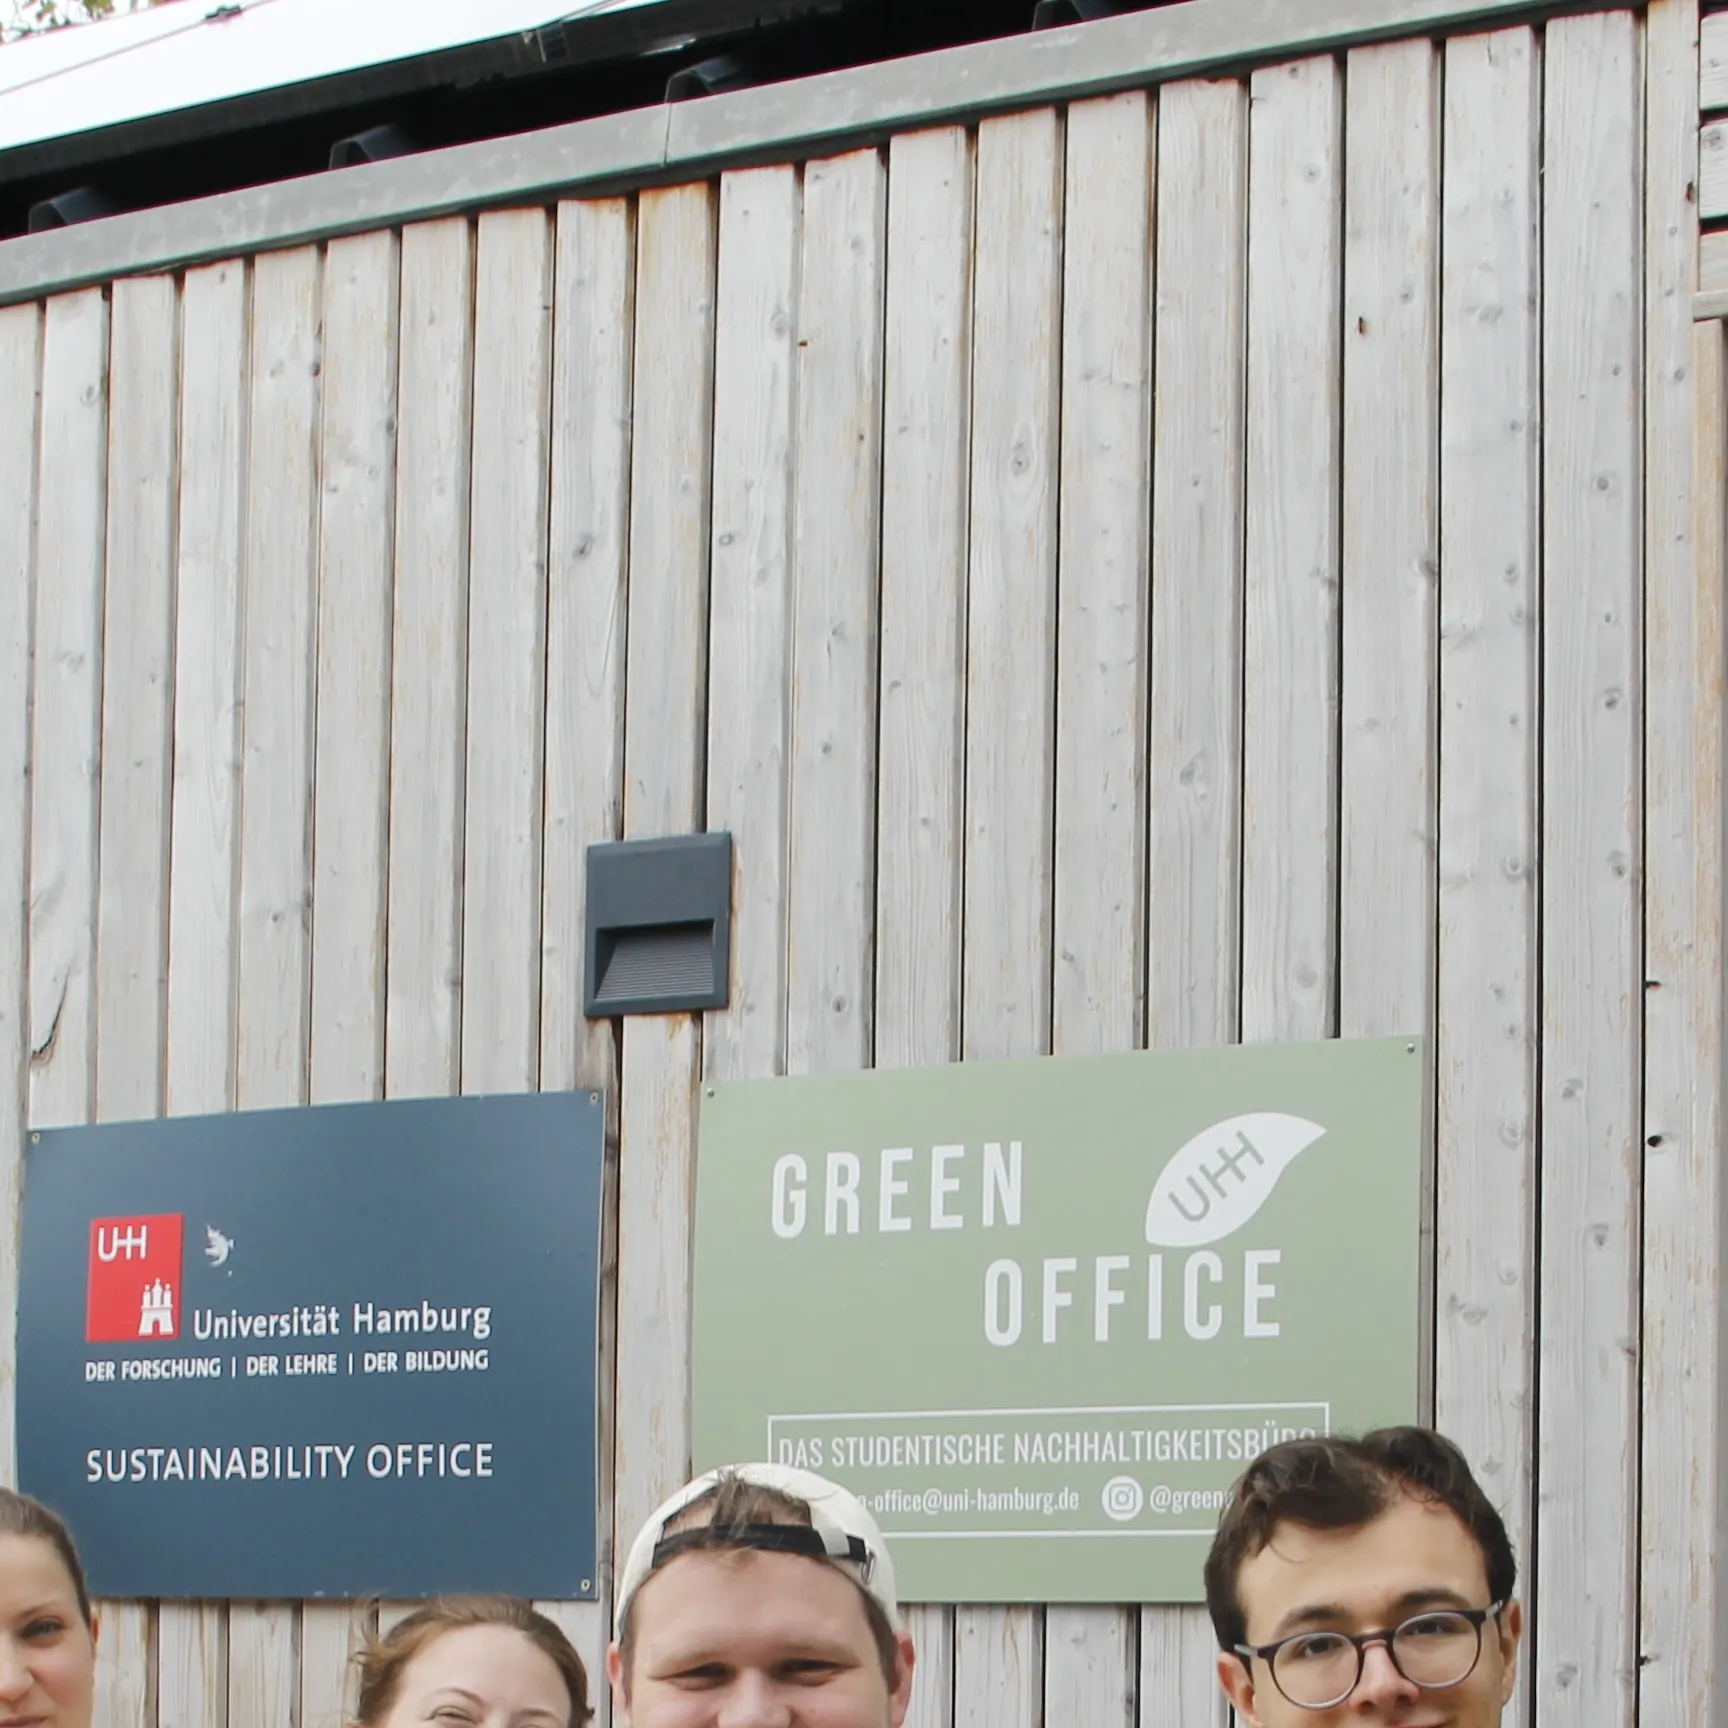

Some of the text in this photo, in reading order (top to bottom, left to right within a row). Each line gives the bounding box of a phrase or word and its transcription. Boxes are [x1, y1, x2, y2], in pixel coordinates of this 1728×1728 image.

[772, 1140, 1024, 1239] GREEN
[983, 1248, 1282, 1347] OFFICE
[193, 1300, 492, 1342] Universität Hamburg
[85, 1348, 489, 1383] DER FORSCHUNG DER LEHRE DER BILDUNG
[86, 1441, 494, 1484] SUSTAINABILITY OFFICE
[779, 1437, 824, 1469] DAS
[831, 1433, 1005, 1467] STUDENTISCHE
[856, 1484, 1232, 1515] n-office@uni-hamburg.de @green
